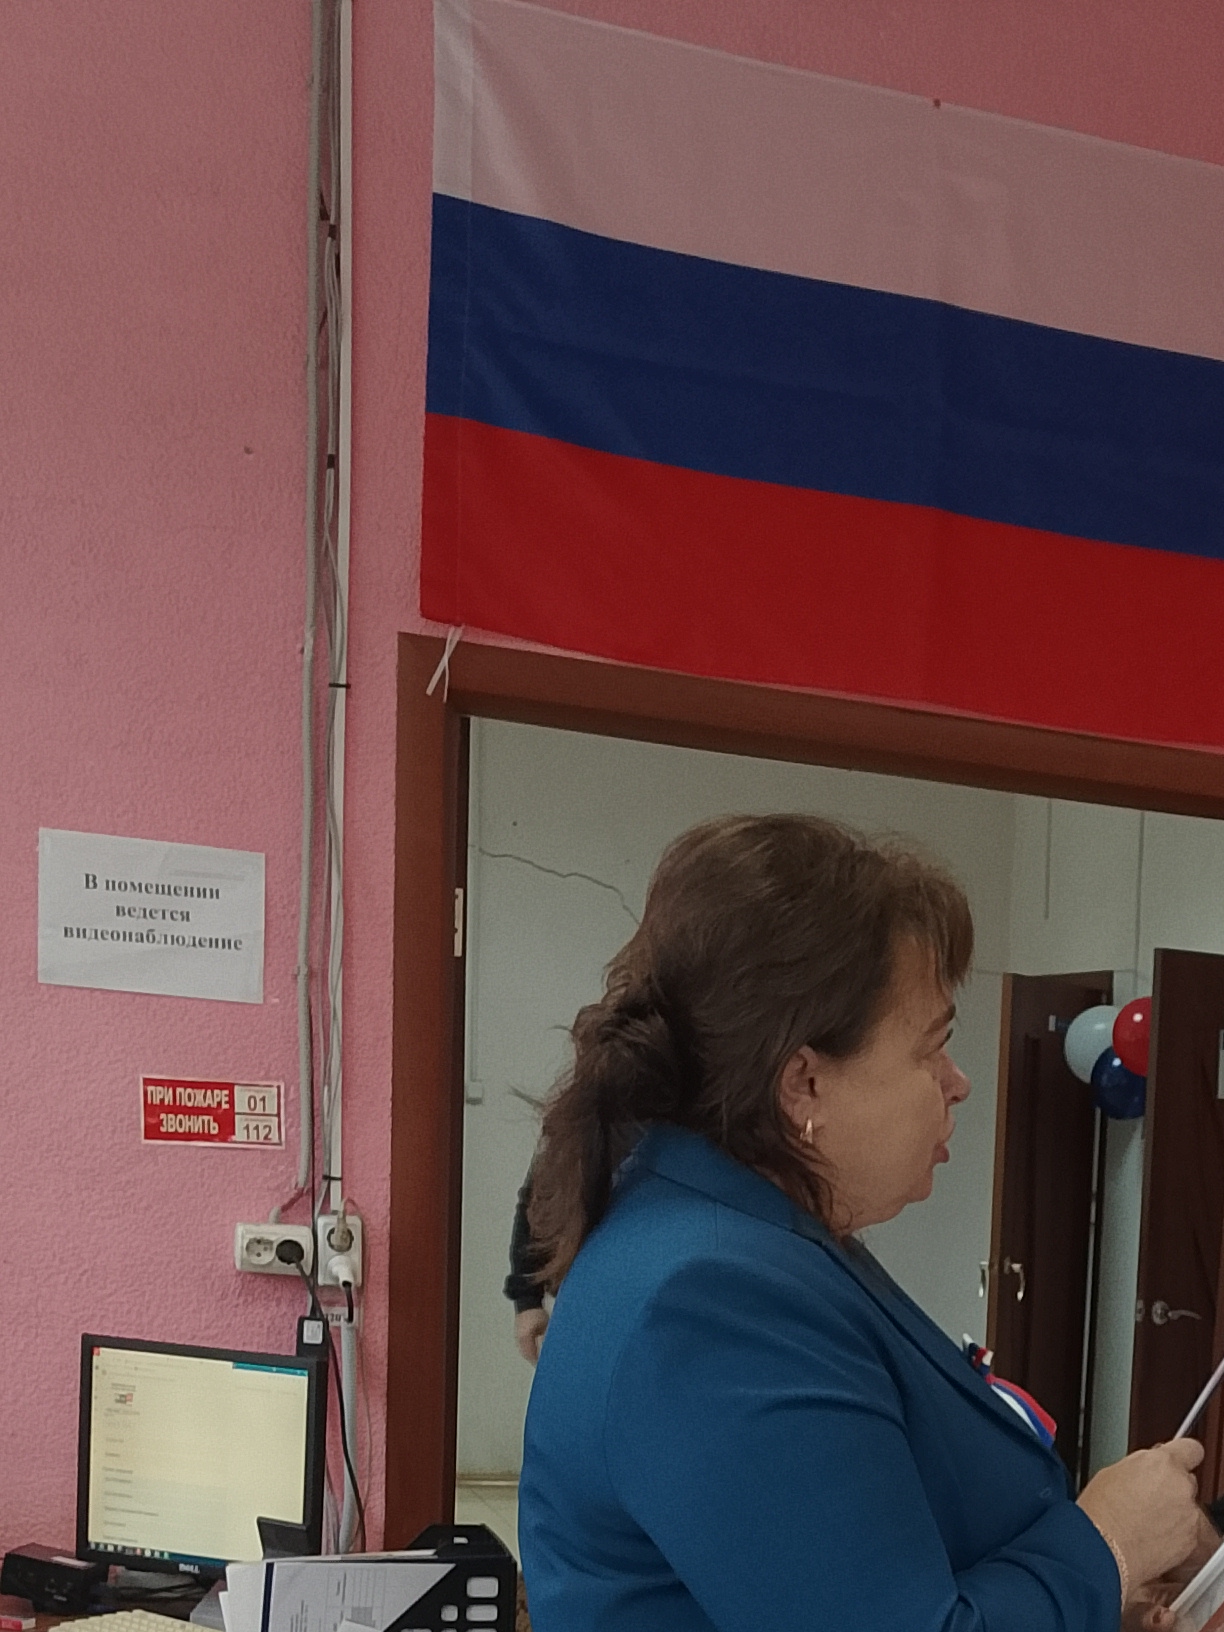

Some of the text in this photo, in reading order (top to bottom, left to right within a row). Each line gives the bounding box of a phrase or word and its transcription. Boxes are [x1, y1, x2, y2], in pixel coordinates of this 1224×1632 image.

[85, 873, 220, 900] В помещении
[115, 905, 191, 922] ведется
[63, 926, 243, 950] видеонаблюдение
[147, 1085, 230, 1109] ПРИ ПОЖАРЕ
[247, 1094, 267, 1112] 01
[160, 1113, 219, 1134] ЗВОНИТЬ
[243, 1123, 272, 1141] 112
